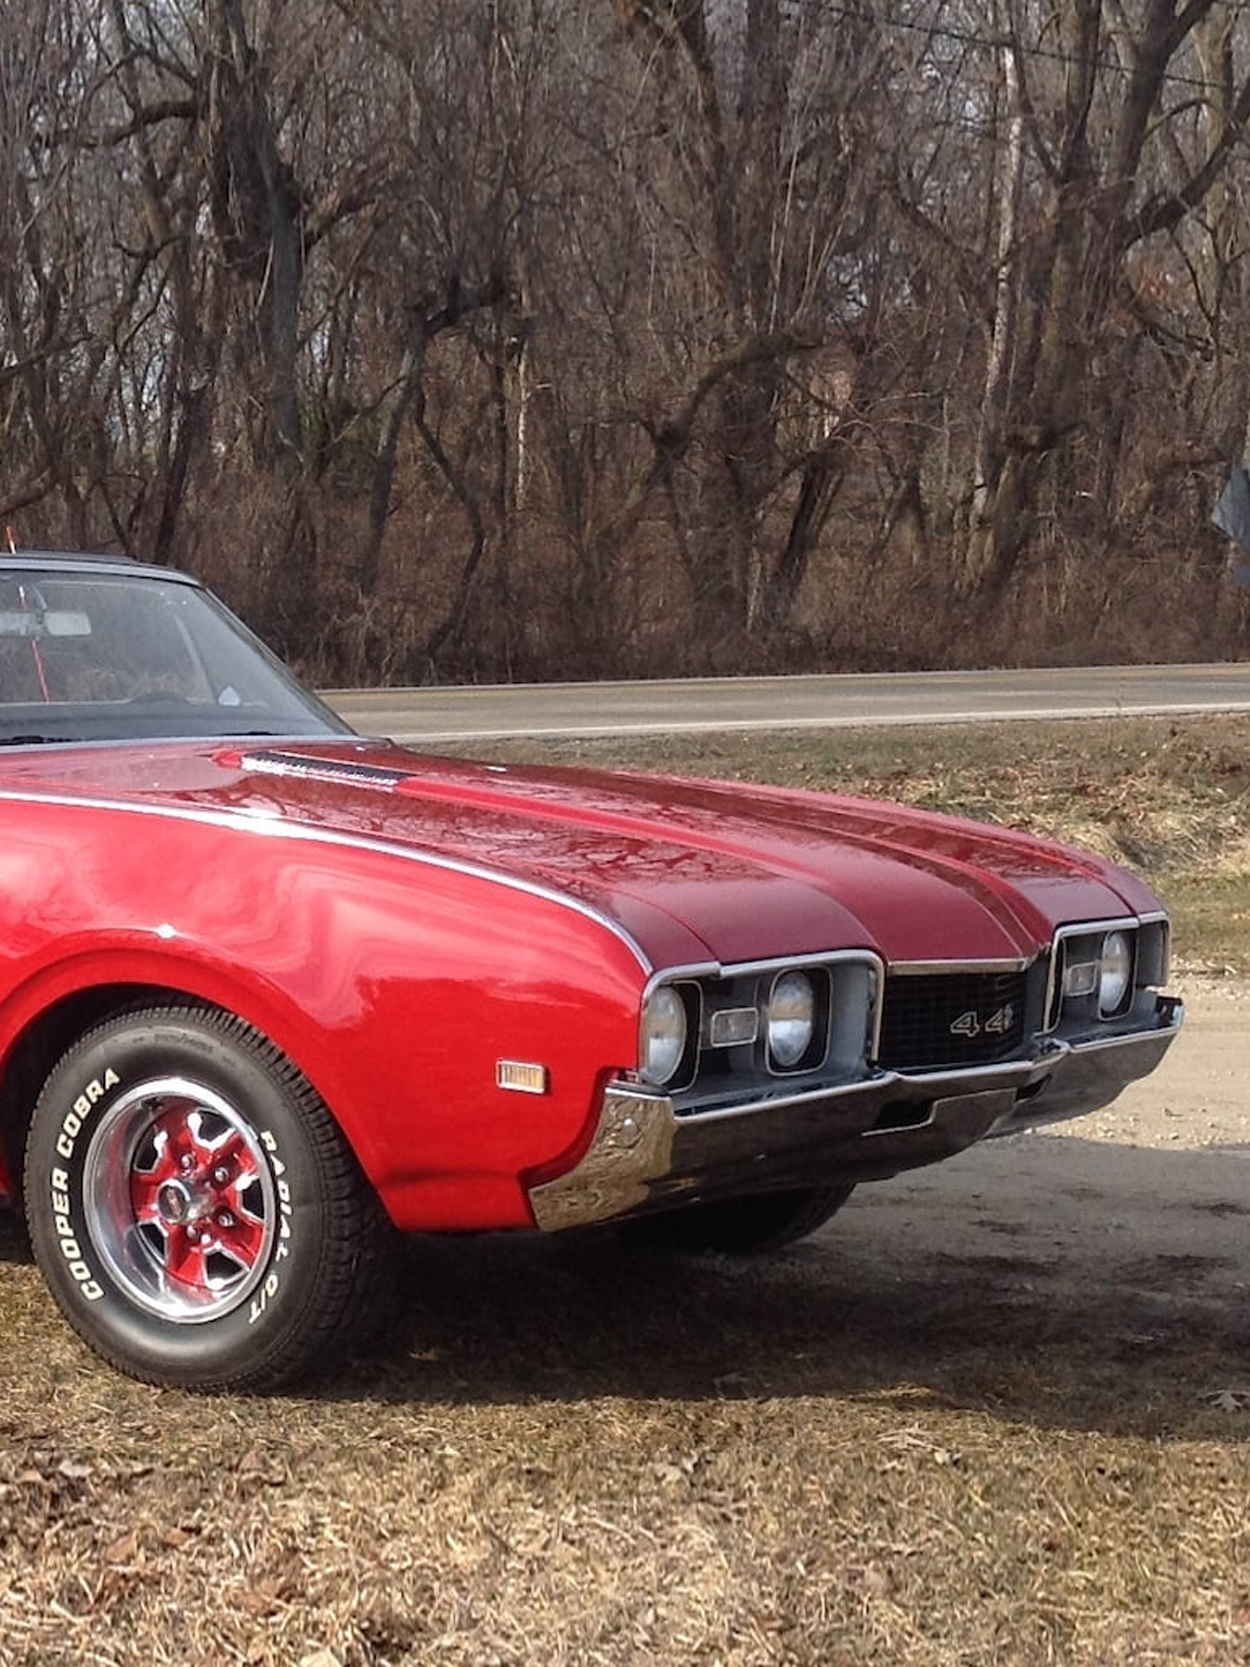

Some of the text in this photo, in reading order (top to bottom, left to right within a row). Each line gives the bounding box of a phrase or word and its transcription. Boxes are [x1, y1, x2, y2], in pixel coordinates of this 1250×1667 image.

[51, 1067, 120, 1300] COOPER COBRA
[261, 1130, 293, 1262] RADIAL
